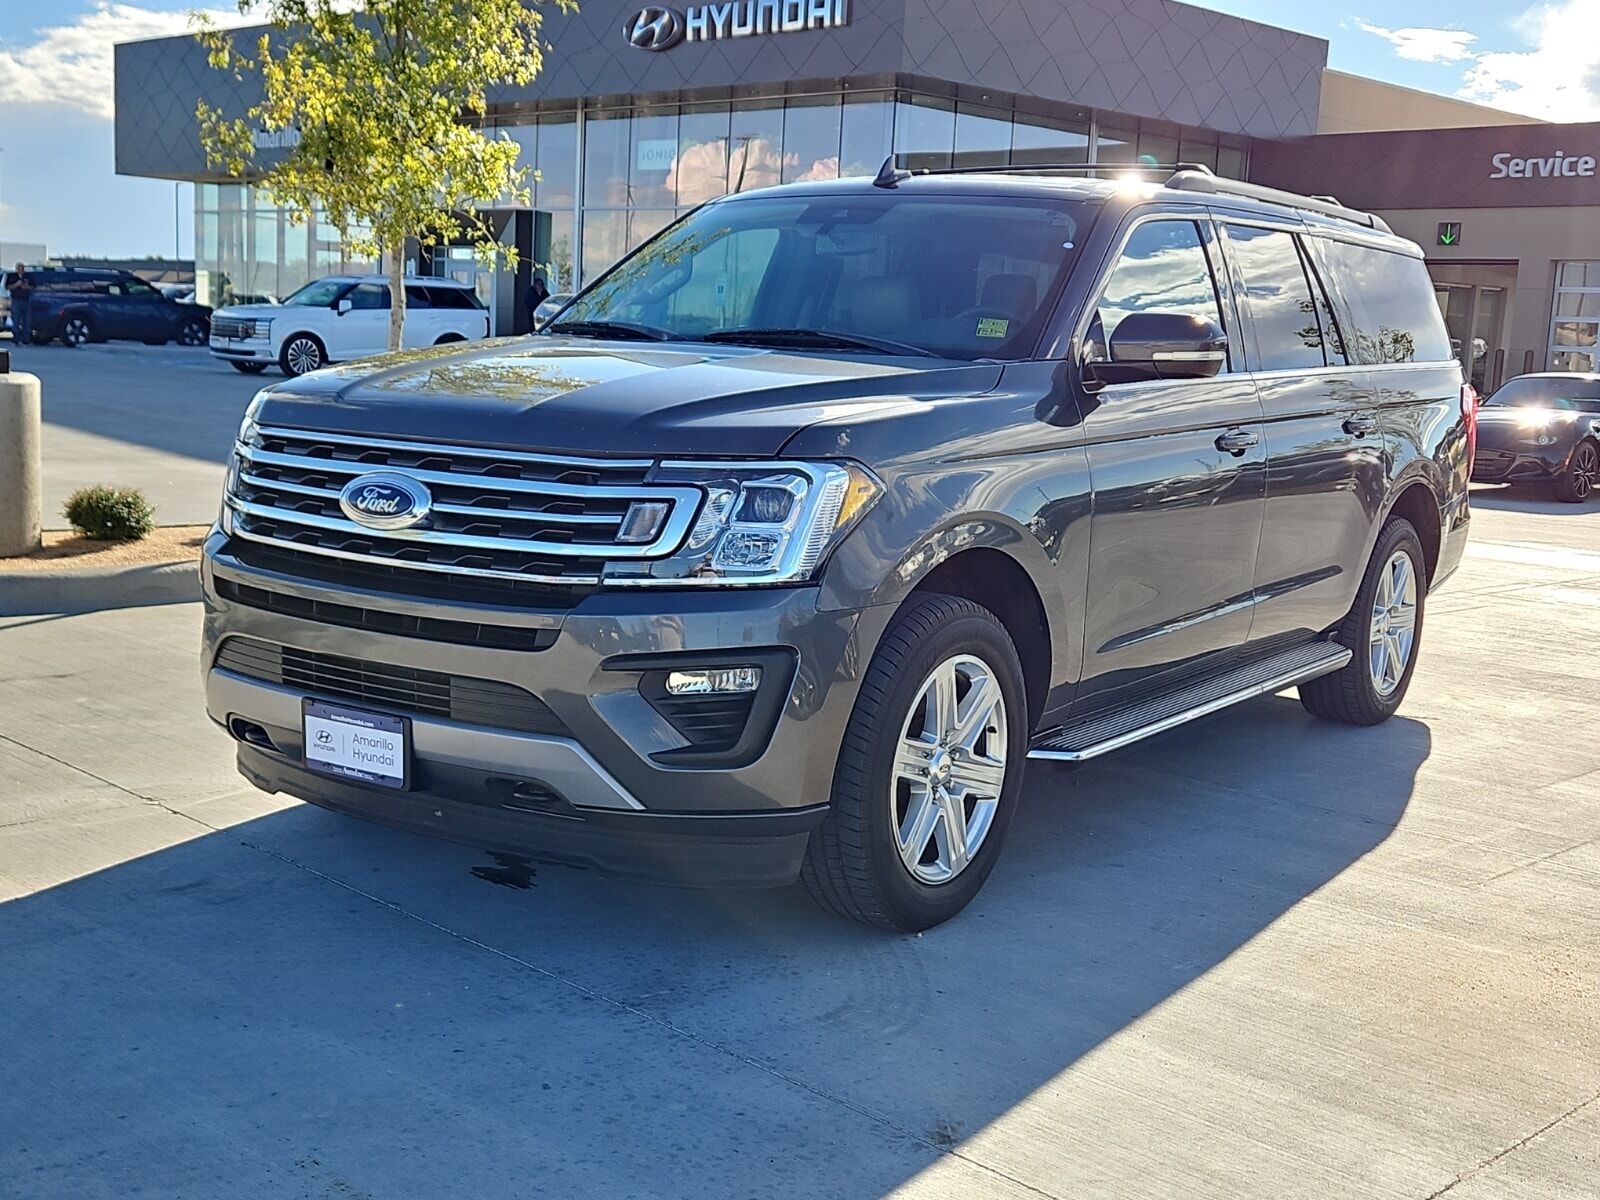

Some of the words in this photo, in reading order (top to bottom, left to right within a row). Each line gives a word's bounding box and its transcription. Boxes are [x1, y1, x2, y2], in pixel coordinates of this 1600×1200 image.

[686, 0, 847, 42] HYUNDAI
[1489, 150, 1596, 179] Service
[356, 486, 400, 513] Ford
[352, 733, 394, 751] Amarillo
[352, 748, 394, 767] Hyundai
